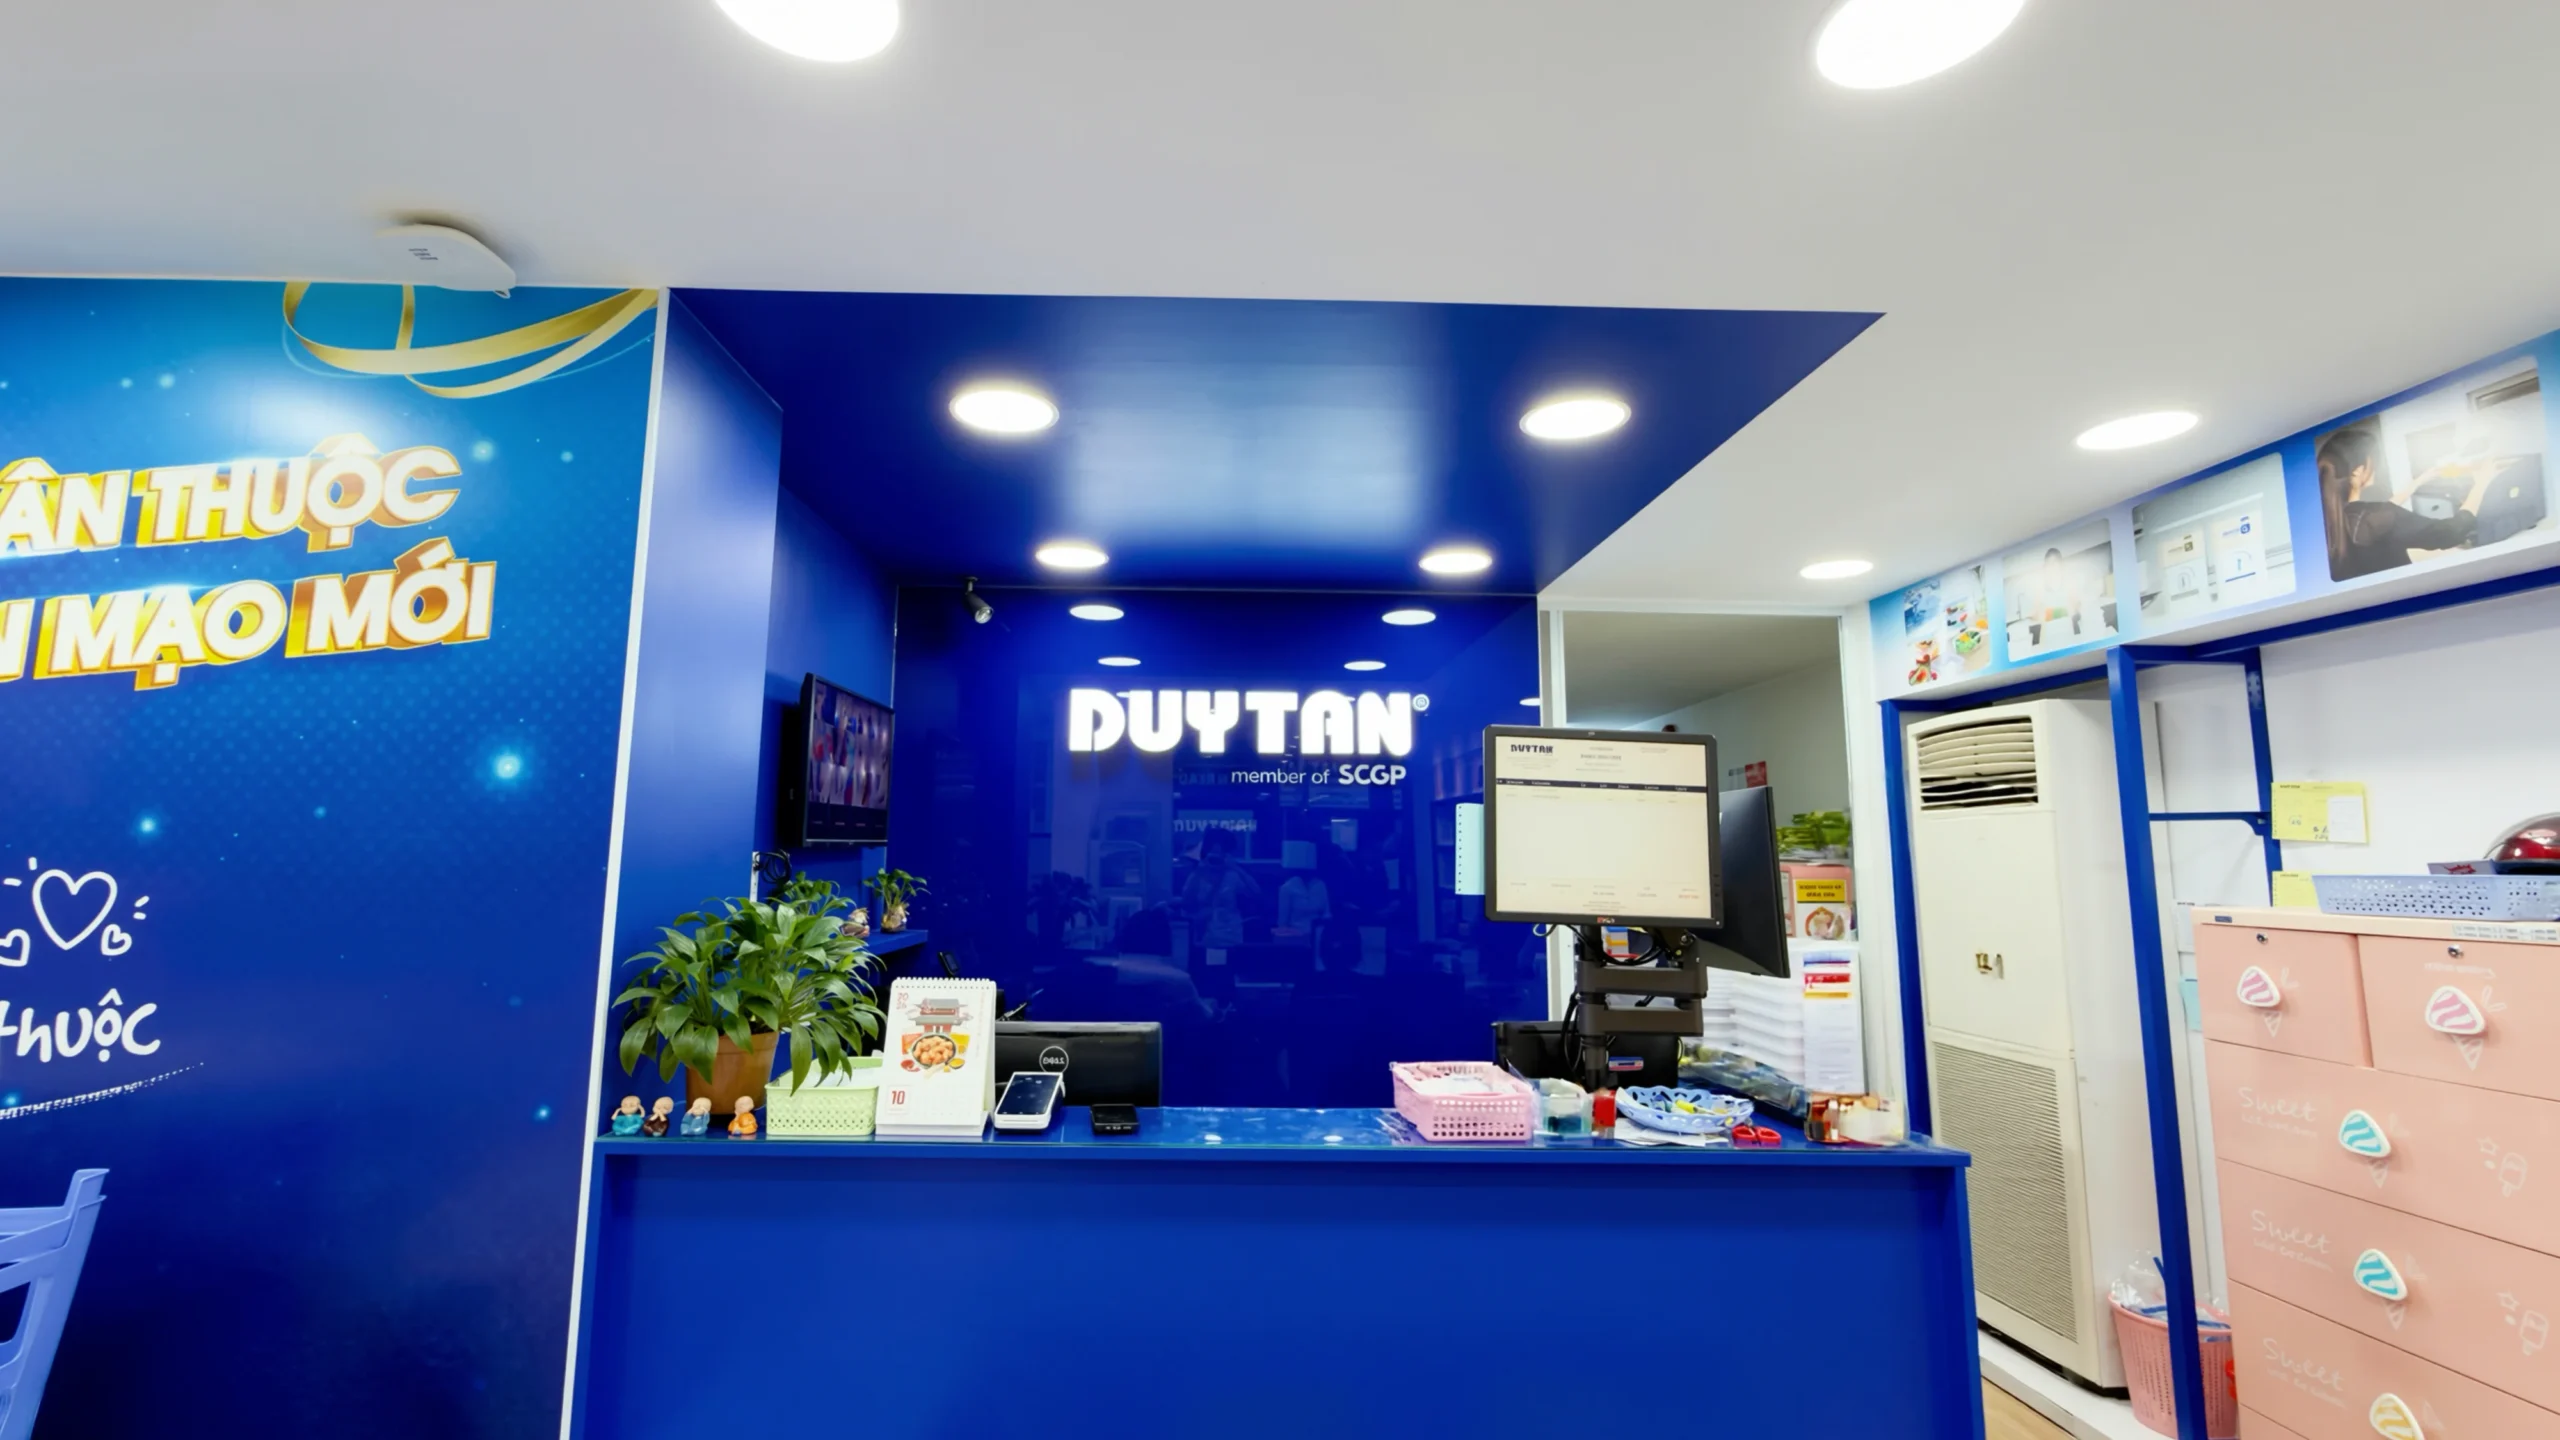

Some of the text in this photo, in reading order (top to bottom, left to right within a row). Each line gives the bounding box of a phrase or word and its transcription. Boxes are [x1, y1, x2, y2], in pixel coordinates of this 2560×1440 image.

[131, 433, 462, 552] THUỘC
[33, 579, 288, 691] MẠO
[285, 536, 497, 658] MỚI
[1231, 768, 1307, 784] member
[1311, 769, 1331, 784] of
[1338, 764, 1407, 785] SCGP
[891, 1090, 906, 1105] 10
